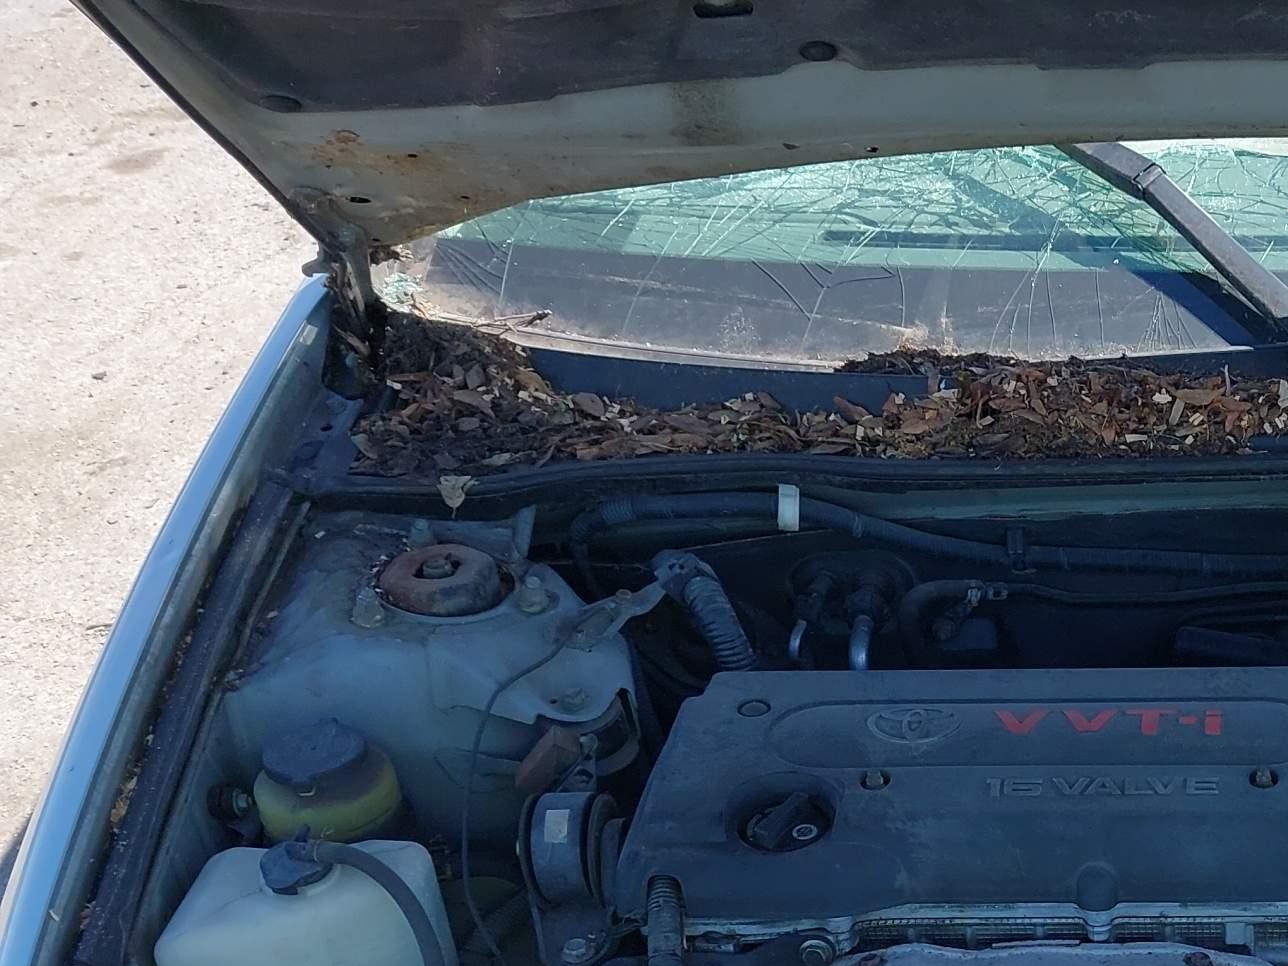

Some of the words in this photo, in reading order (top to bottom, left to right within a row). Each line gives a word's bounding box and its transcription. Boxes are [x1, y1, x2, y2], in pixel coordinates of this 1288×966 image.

[994, 709, 1223, 736] VVT-i
[986, 776, 1044, 797] 16
[1052, 776, 1220, 797] VALVE
